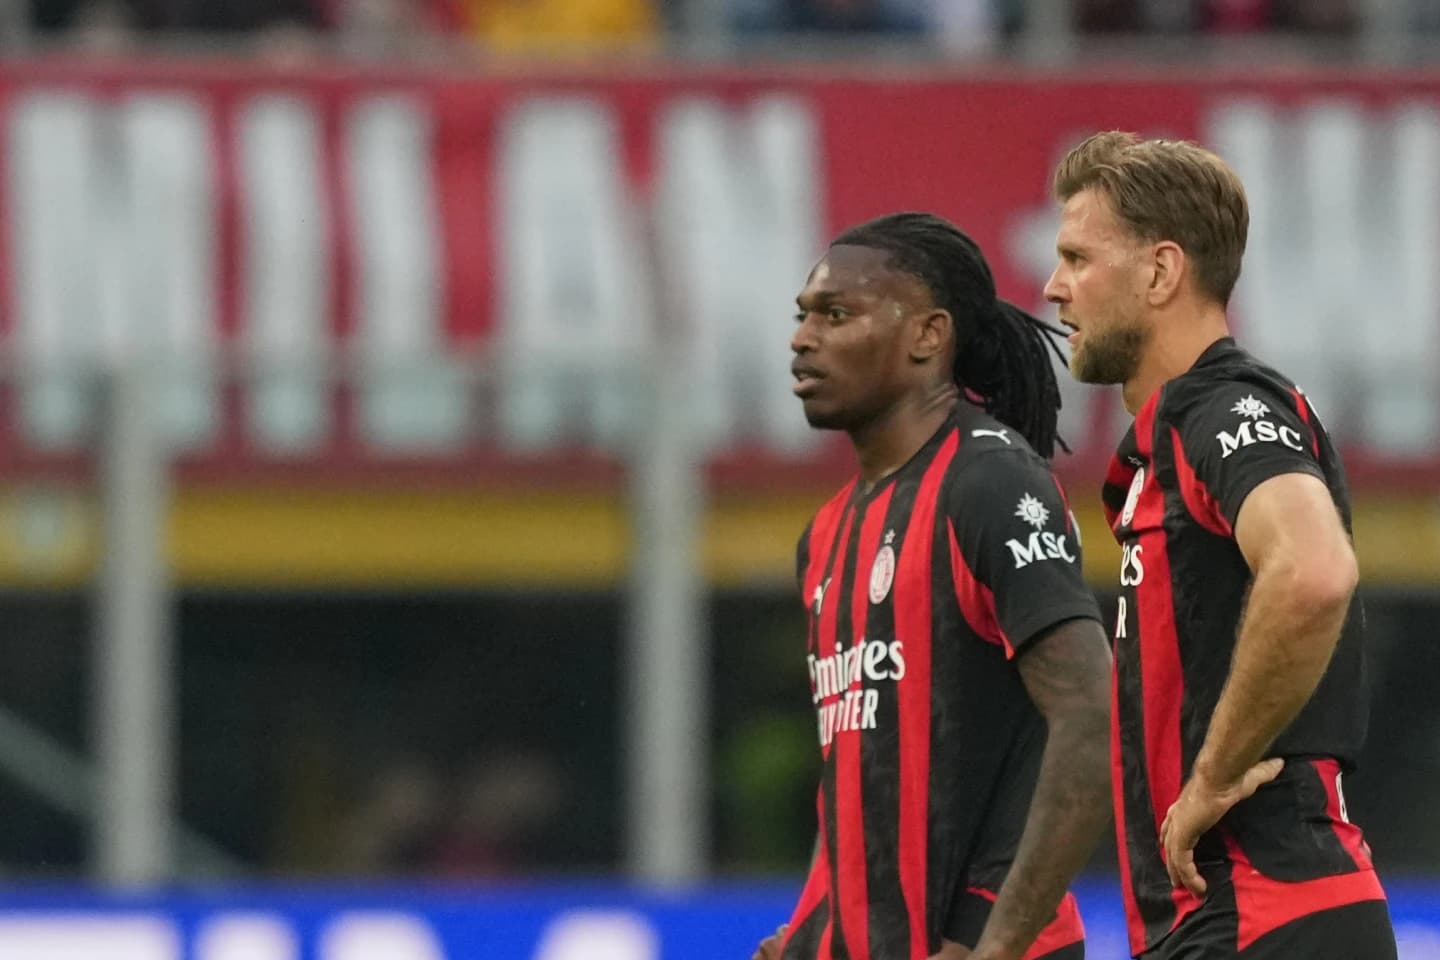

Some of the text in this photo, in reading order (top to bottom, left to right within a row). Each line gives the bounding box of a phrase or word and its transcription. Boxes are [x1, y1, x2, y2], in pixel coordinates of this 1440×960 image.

[10, 92, 828, 456] MILAN
[1214, 420, 1304, 459] MSC
[1005, 531, 1076, 569] MSC
